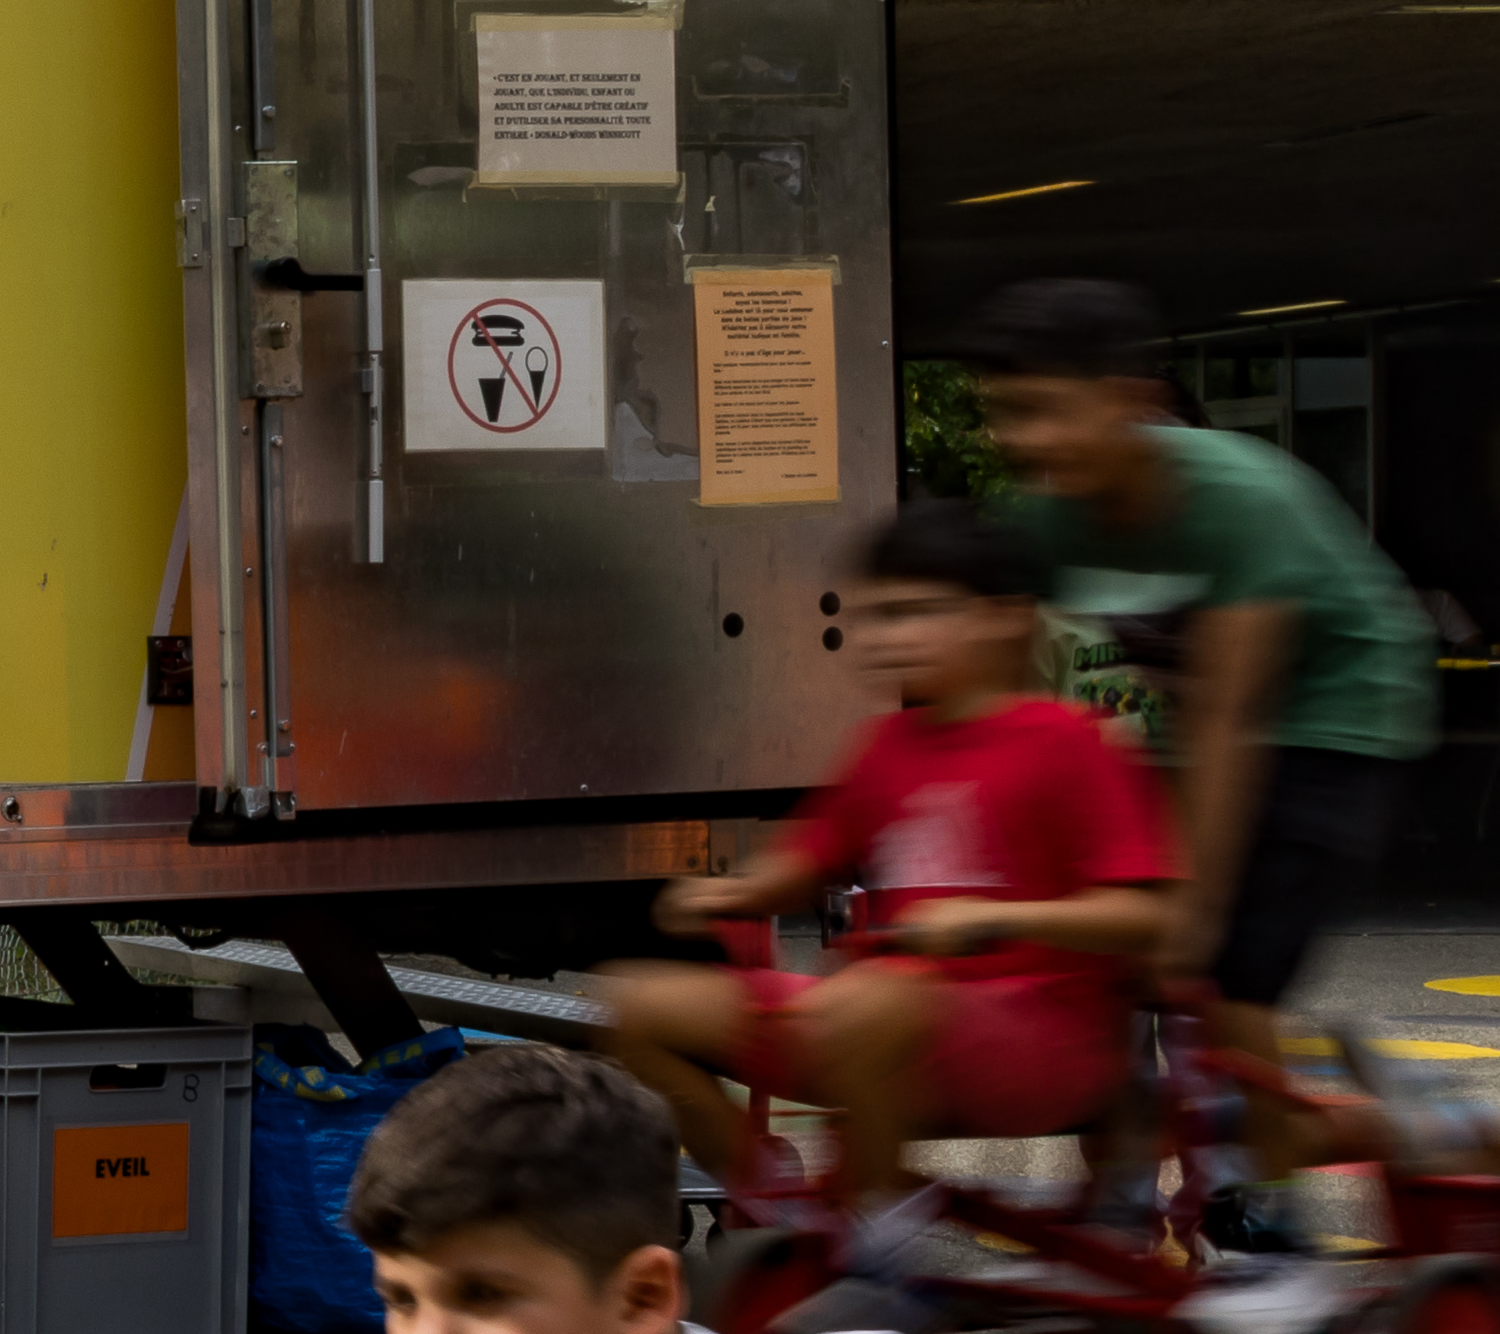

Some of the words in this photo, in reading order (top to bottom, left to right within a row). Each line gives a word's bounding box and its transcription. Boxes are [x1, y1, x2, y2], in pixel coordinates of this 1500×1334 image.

[570, 74, 580, 82] ET
[527, 102, 543, 111] EST
[95, 1156, 151, 1179] EVEIL
